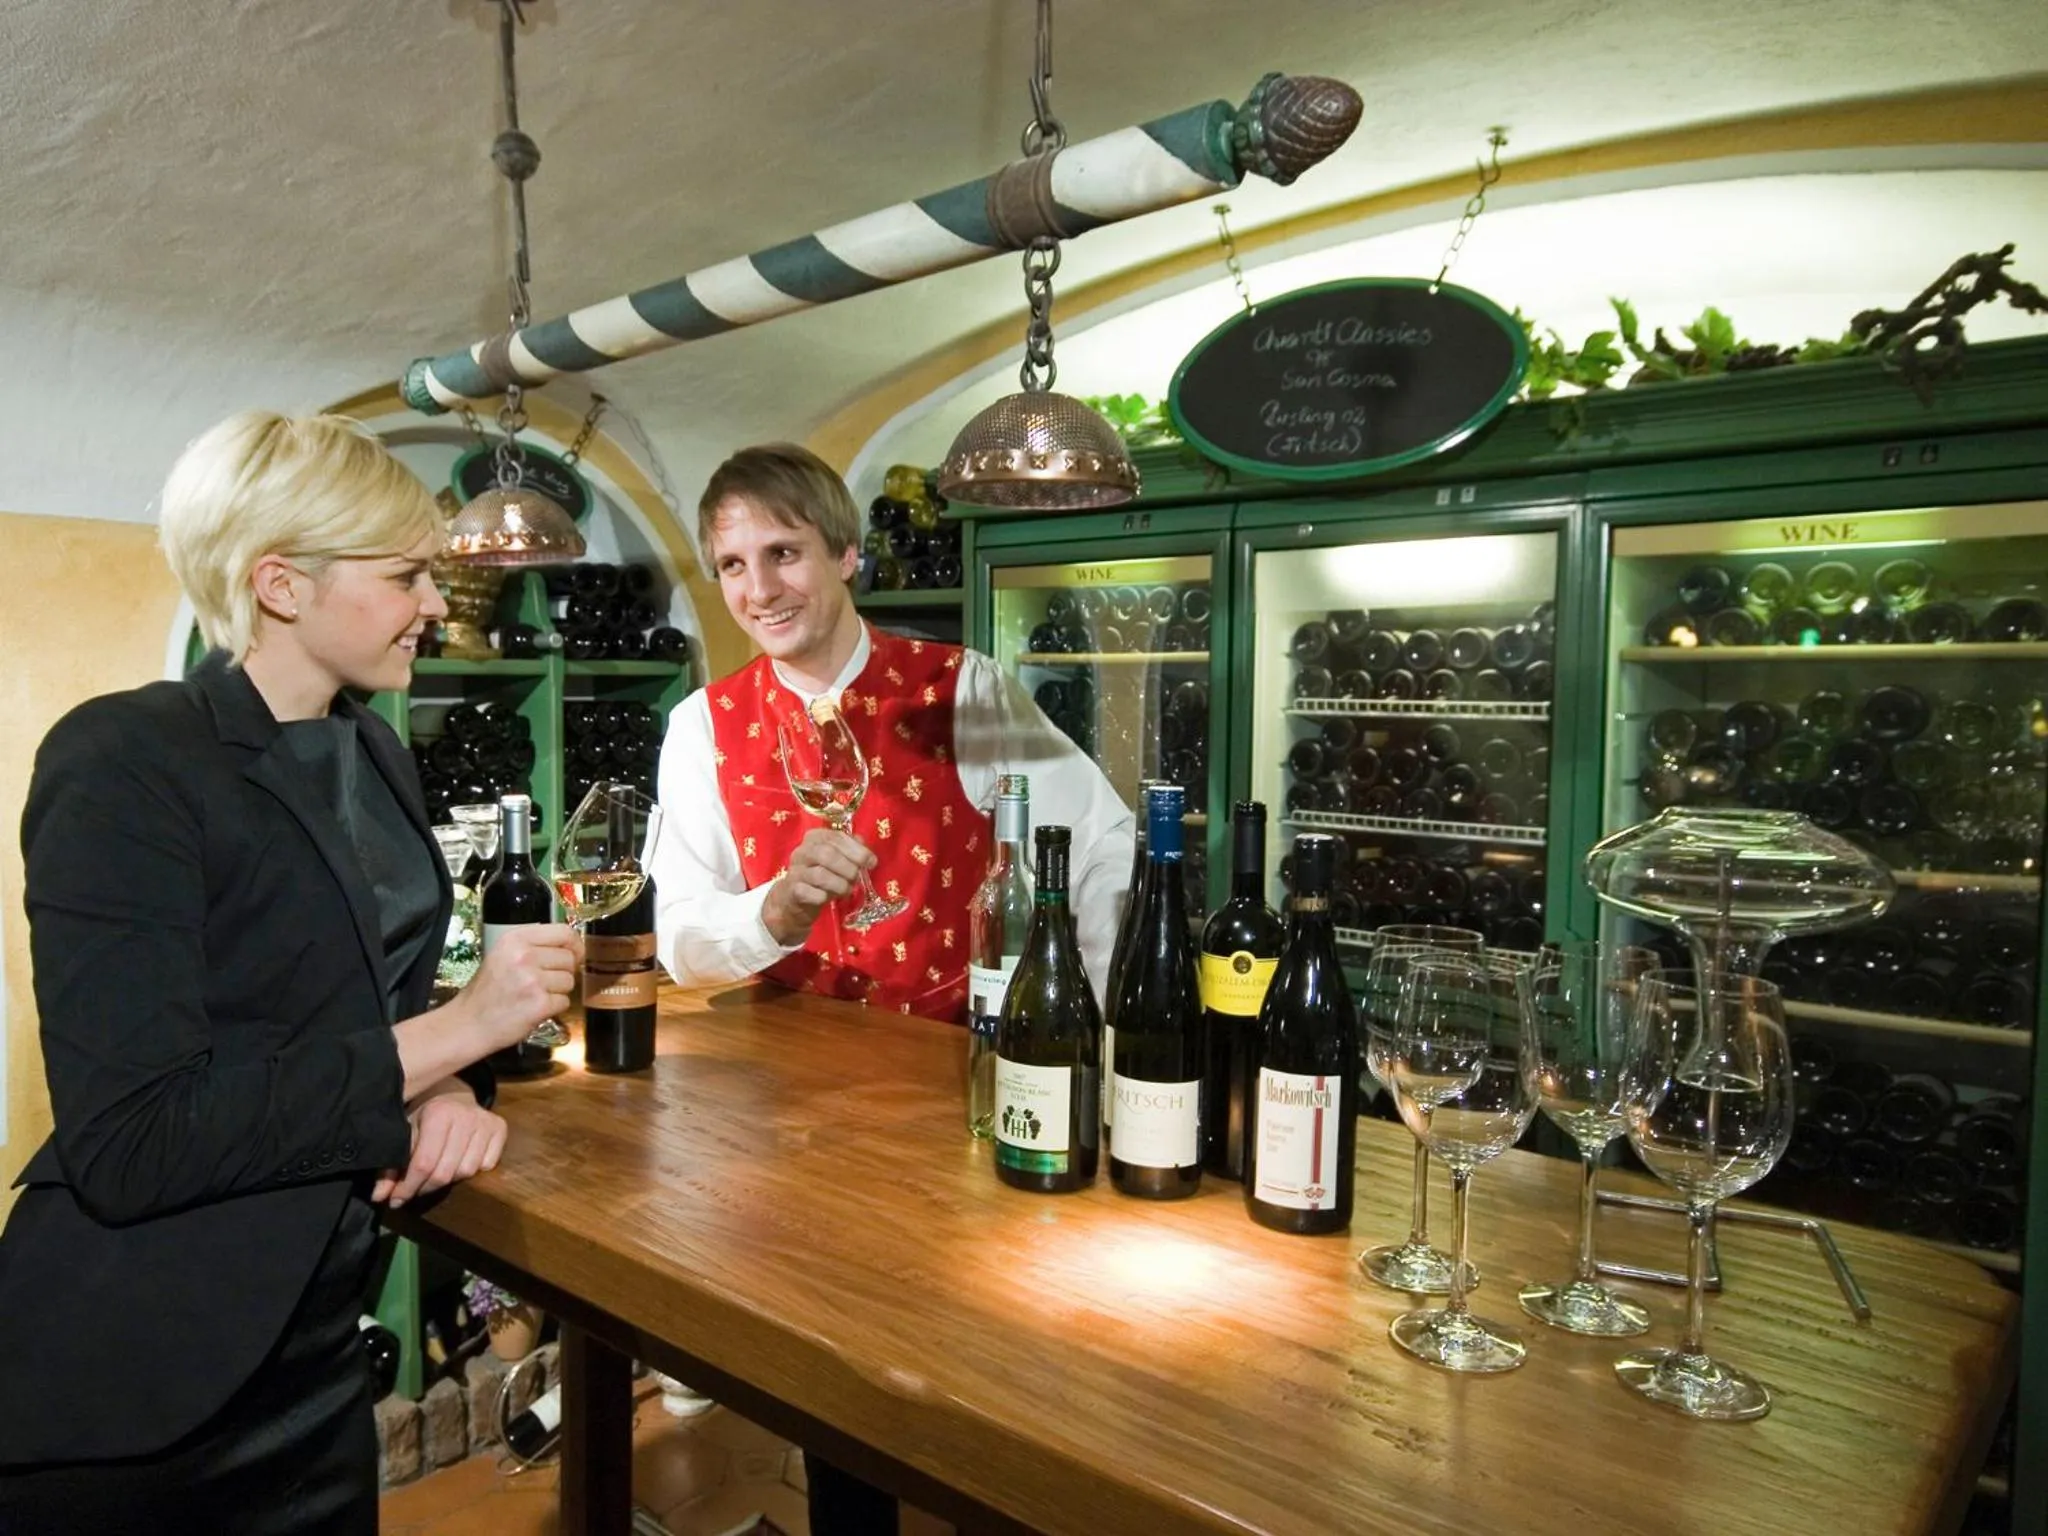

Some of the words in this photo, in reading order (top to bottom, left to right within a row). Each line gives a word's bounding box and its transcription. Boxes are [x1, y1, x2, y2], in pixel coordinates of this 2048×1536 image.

[1780, 521, 1859, 542] WINE
[1075, 567, 1116, 581] WINE
[1265, 1076, 1333, 1109] Markowitsch
